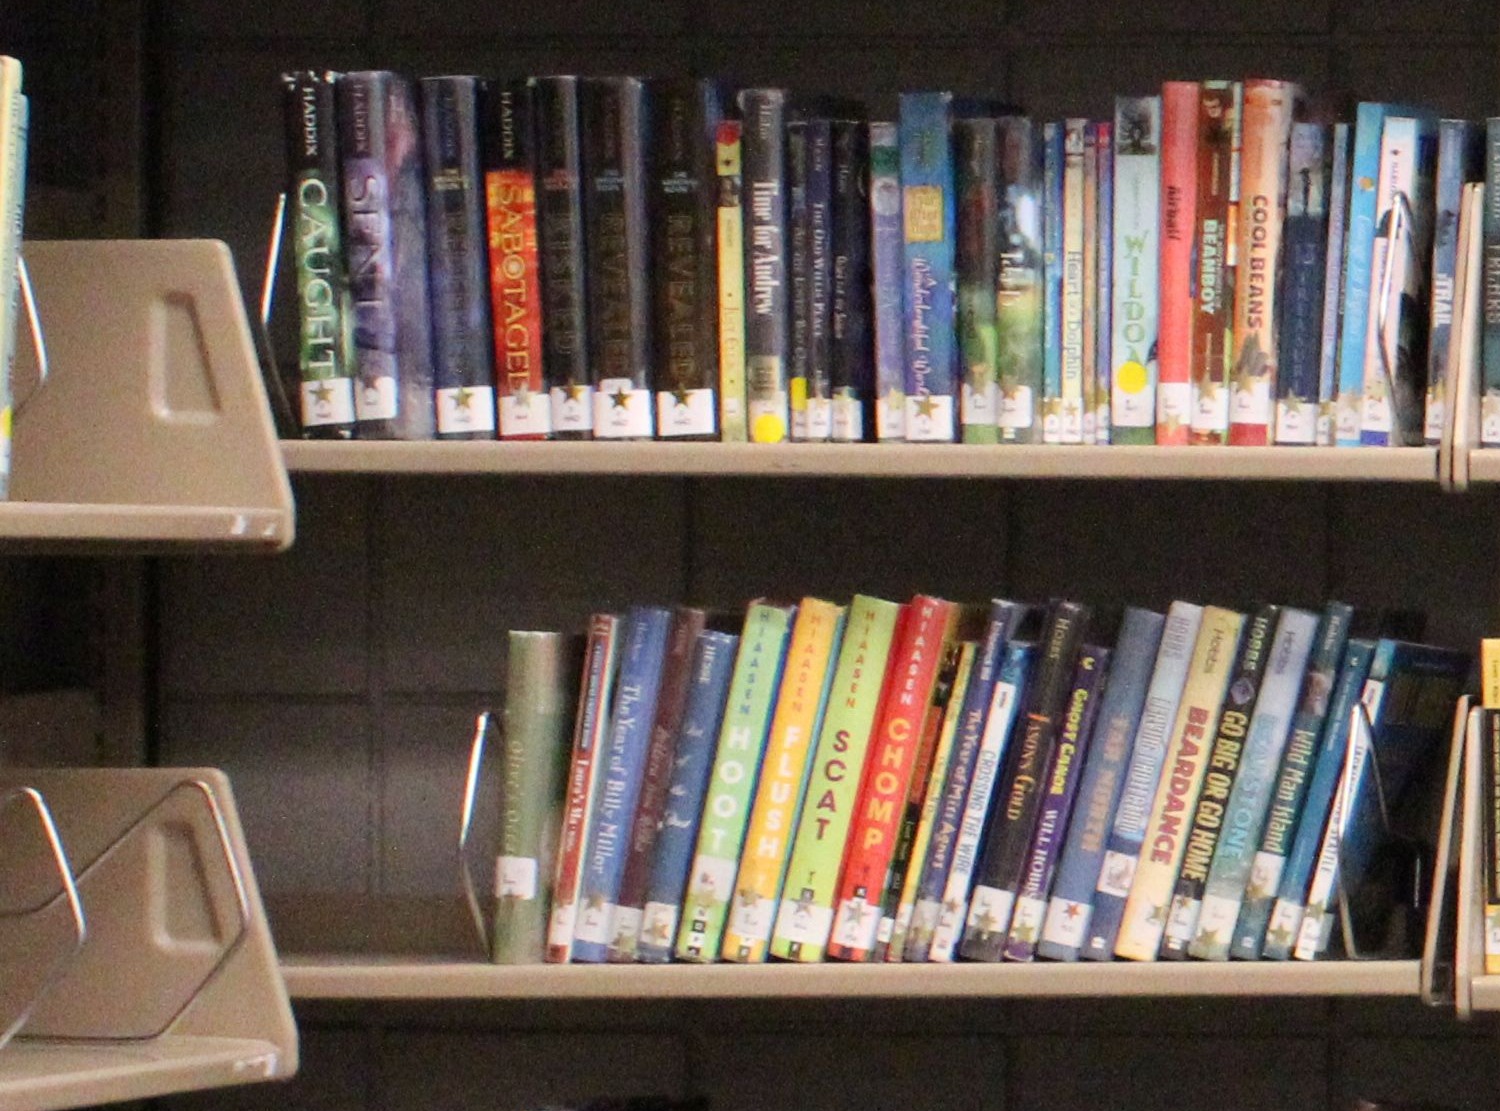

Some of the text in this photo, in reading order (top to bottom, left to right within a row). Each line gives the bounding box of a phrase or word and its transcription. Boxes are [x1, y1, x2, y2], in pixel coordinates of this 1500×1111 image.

[298, 86, 335, 373] HADDIX CAUGHT
[754, 181, 781, 316] Time for Andrew
[1200, 220, 1218, 314] BEANBOY
[1248, 195, 1268, 328] COOL BEANS
[712, 726, 749, 851] HOOT
[758, 727, 800, 857] FLUSH
[815, 731, 850, 840] SCAT
[864, 719, 911, 851] CHOMP
[1149, 706, 1210, 866] BEARDANCE
[1181, 711, 1247, 881] GO BIG OR GO HOME
